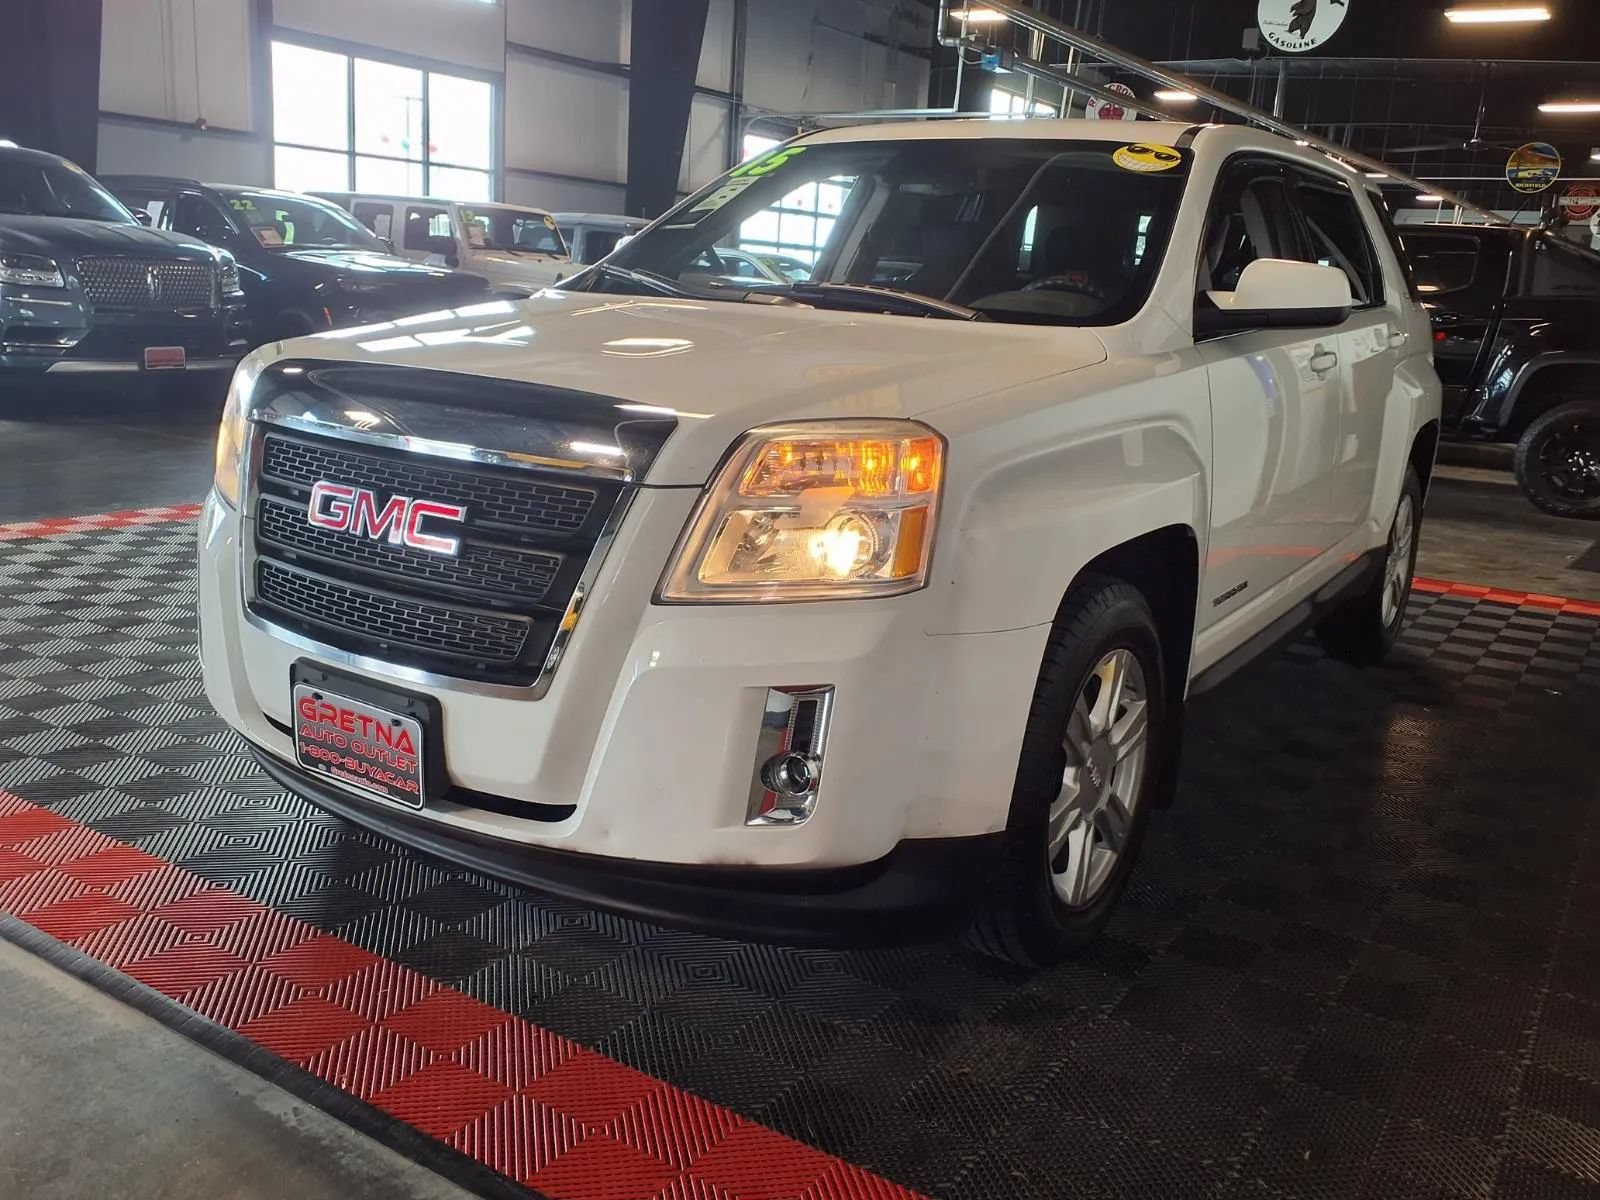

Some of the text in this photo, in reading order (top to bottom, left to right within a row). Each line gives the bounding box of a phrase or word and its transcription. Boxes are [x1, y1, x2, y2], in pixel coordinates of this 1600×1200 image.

[1268, 32, 1317, 49] GASOLINE
[229, 199, 257, 210] 22
[308, 480, 467, 555] GMC
[298, 697, 416, 757] GRETNA
[299, 724, 418, 774] AUTO OUTLET
[300, 742, 419, 794] 1-800-BUYACAR
